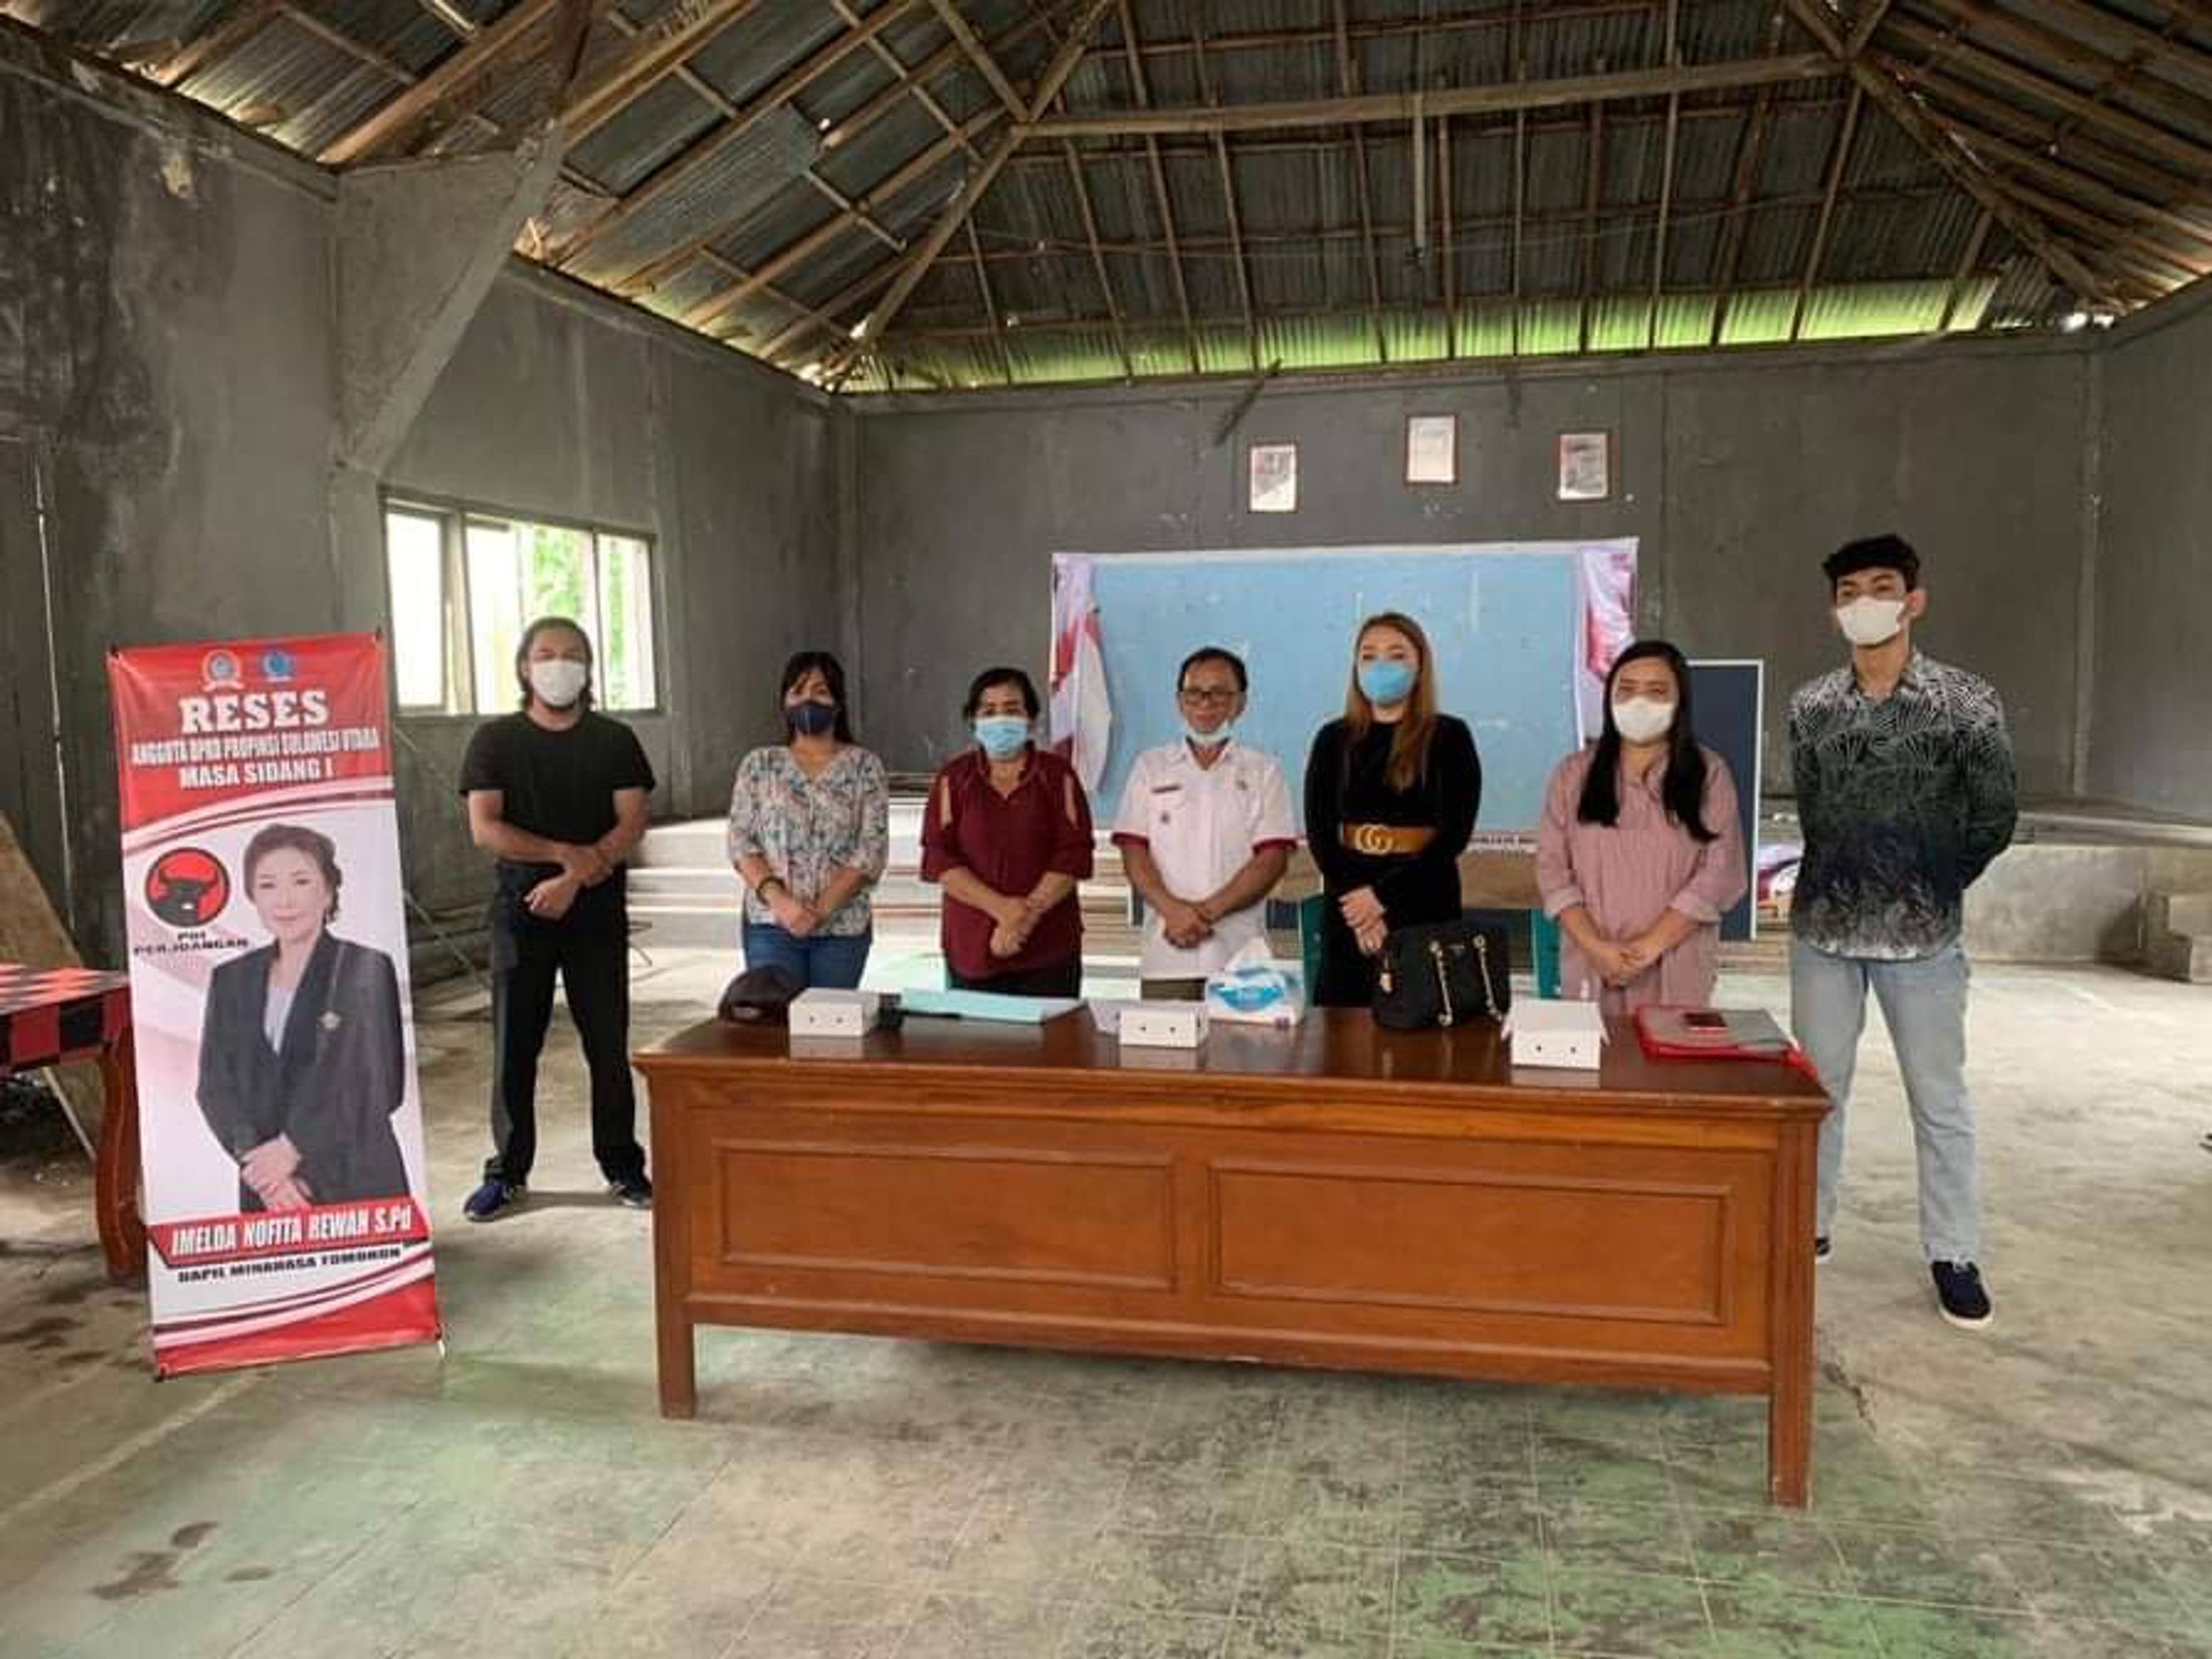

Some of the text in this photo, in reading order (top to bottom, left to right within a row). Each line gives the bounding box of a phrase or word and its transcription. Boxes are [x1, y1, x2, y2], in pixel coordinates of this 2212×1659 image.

[179, 691, 328, 733] RESES
[179, 762, 240, 789] MASA
[244, 757, 320, 785] SIDANG
[172, 1224, 236, 1256] IMELDA
[230, 1257, 316, 1277] MINAHASA
